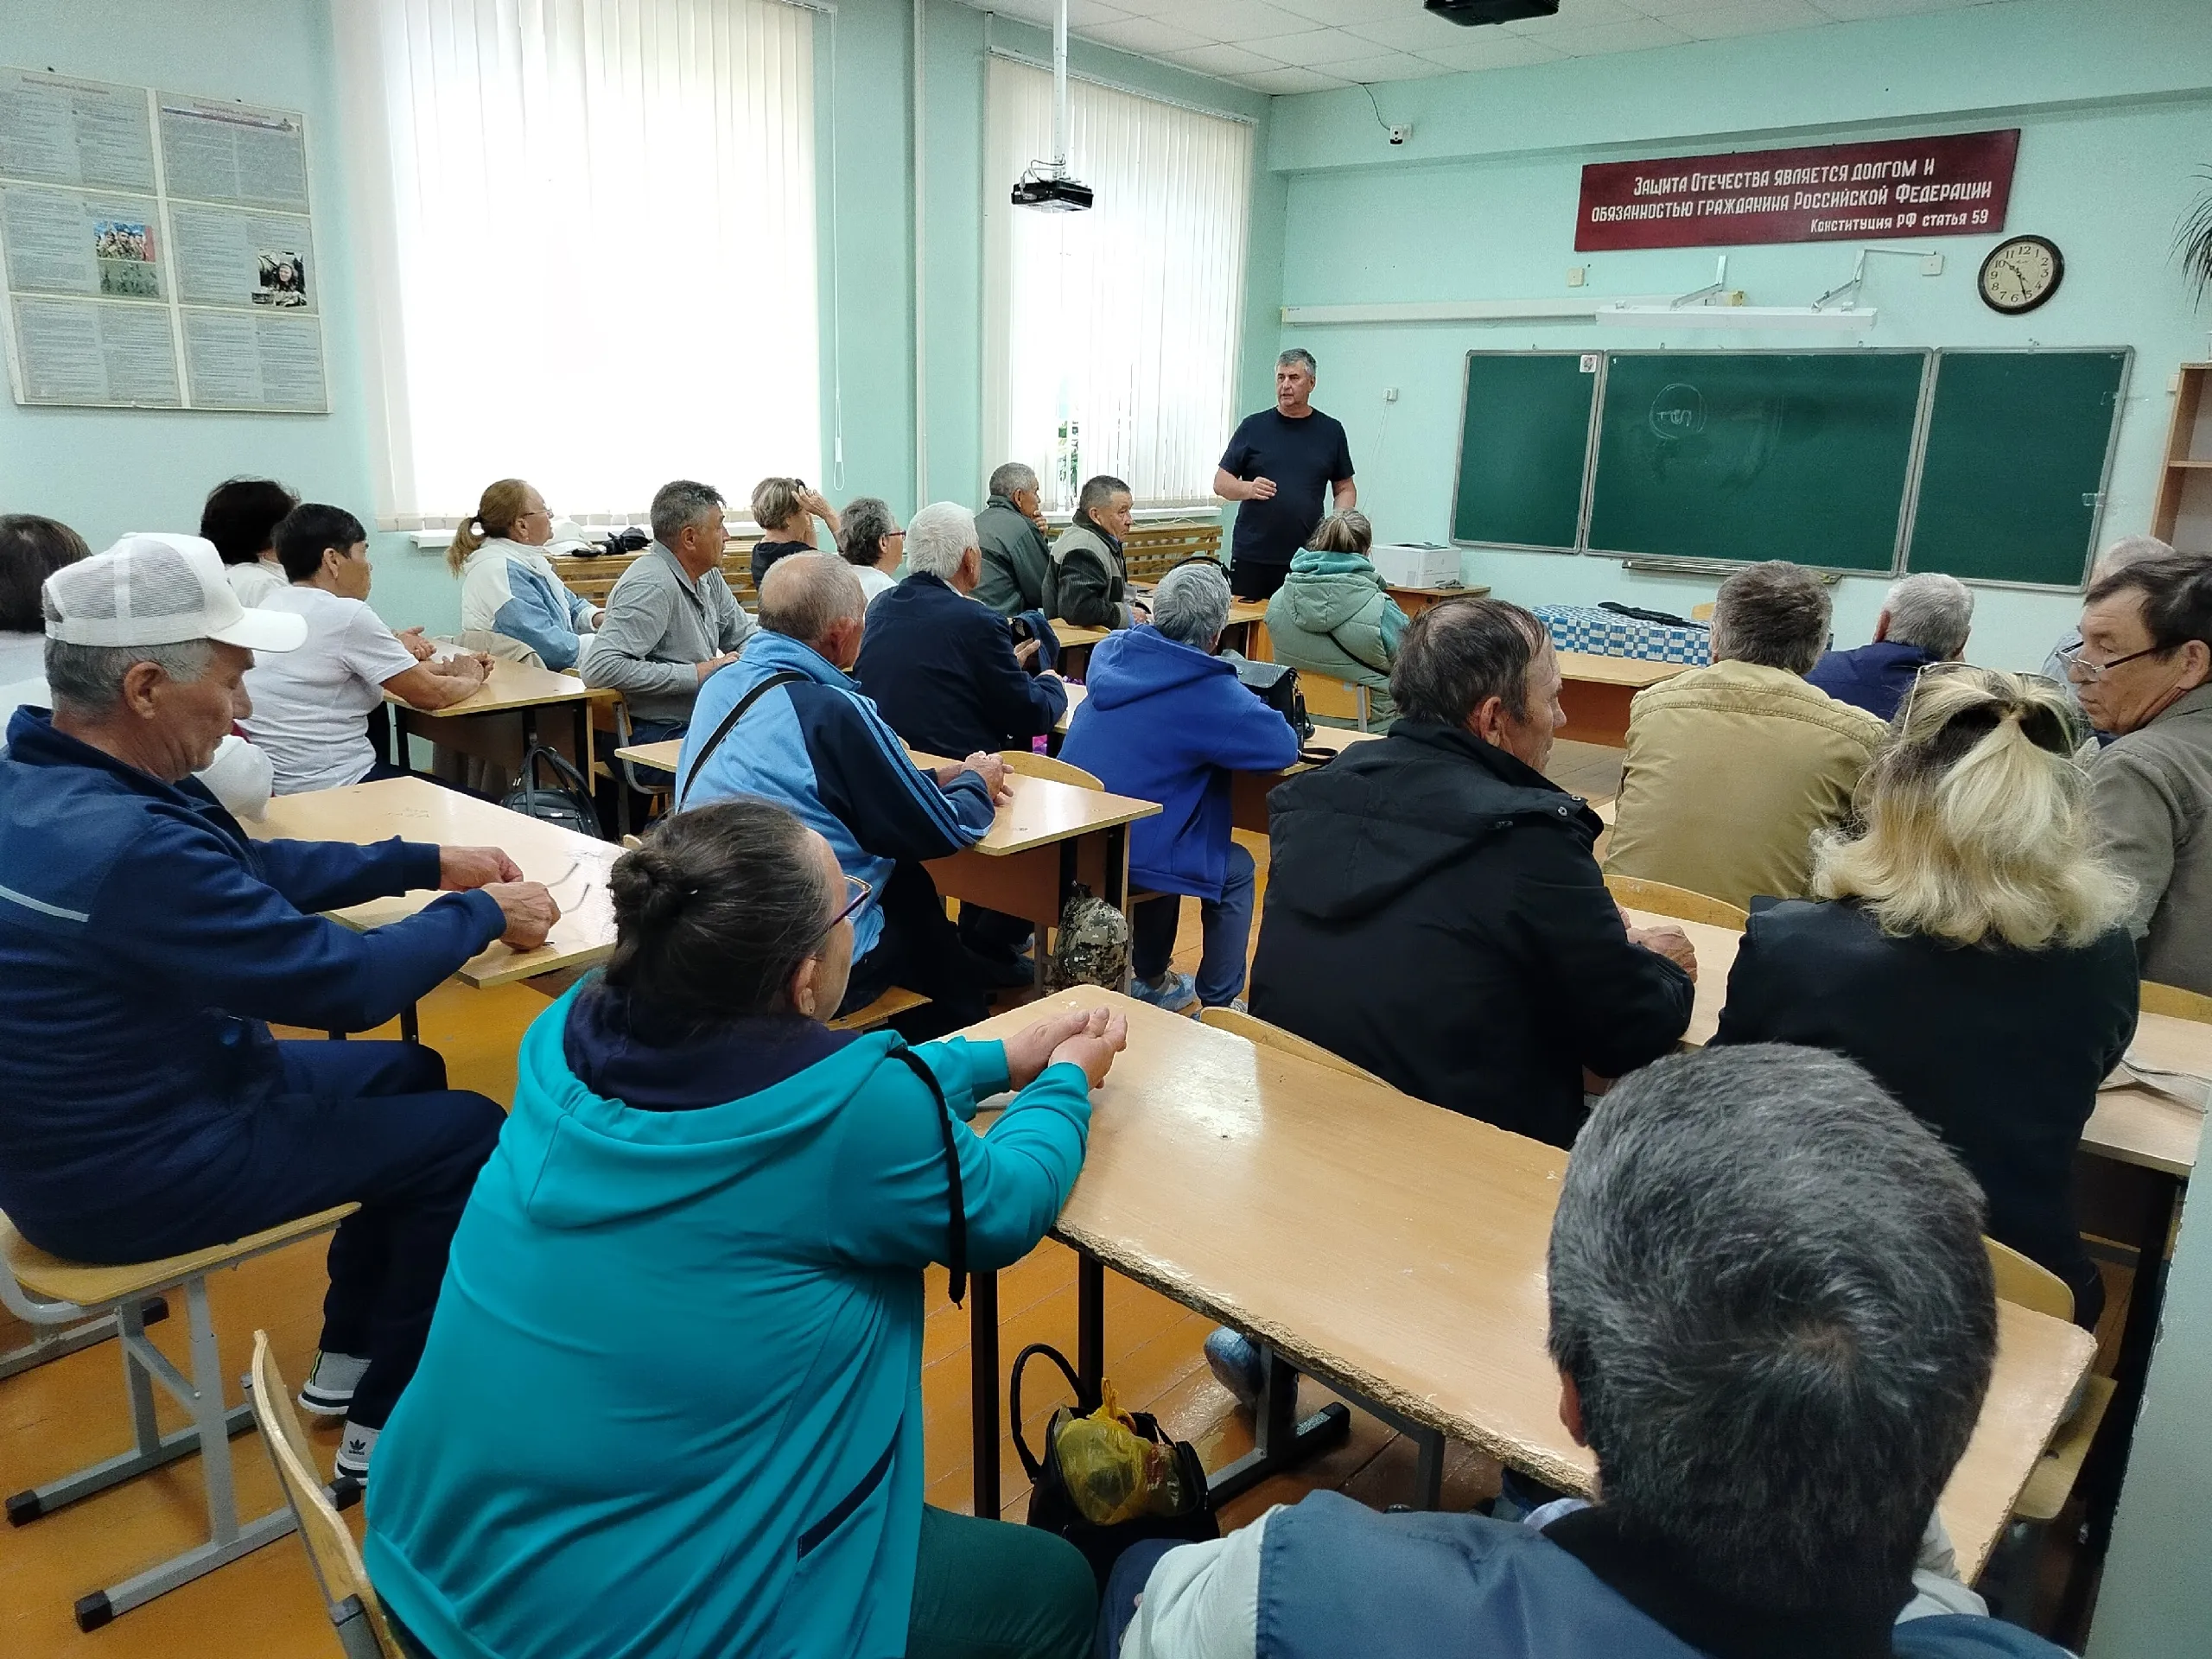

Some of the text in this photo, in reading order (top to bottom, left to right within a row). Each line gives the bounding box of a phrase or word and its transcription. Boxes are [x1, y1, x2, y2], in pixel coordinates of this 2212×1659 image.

[1634, 157, 1936, 196] ЗАЩИТА ОТЕЧЕСТВА ЯВЛЯЕТСЯ ДОЛГОМ И
[1591, 181, 1993, 222] ОБЯЗАННОСТЬЮ ГРАЖДАНИНА РОССИЙСКОЙ ФЕДЕРАЦИИ
[1897, 213, 1917, 228] РФ
[1971, 209, 1989, 225] 59
[2018, 246, 2031, 255] 12
[1994, 259, 2005, 268] 10
[2041, 257, 2049, 266] 2
[2040, 269, 2049, 277] 3
[2035, 281, 2042, 289] 4
[1999, 291, 2007, 300] 7
[2011, 294, 2019, 302] 6
[2025, 289, 2033, 299] 5
